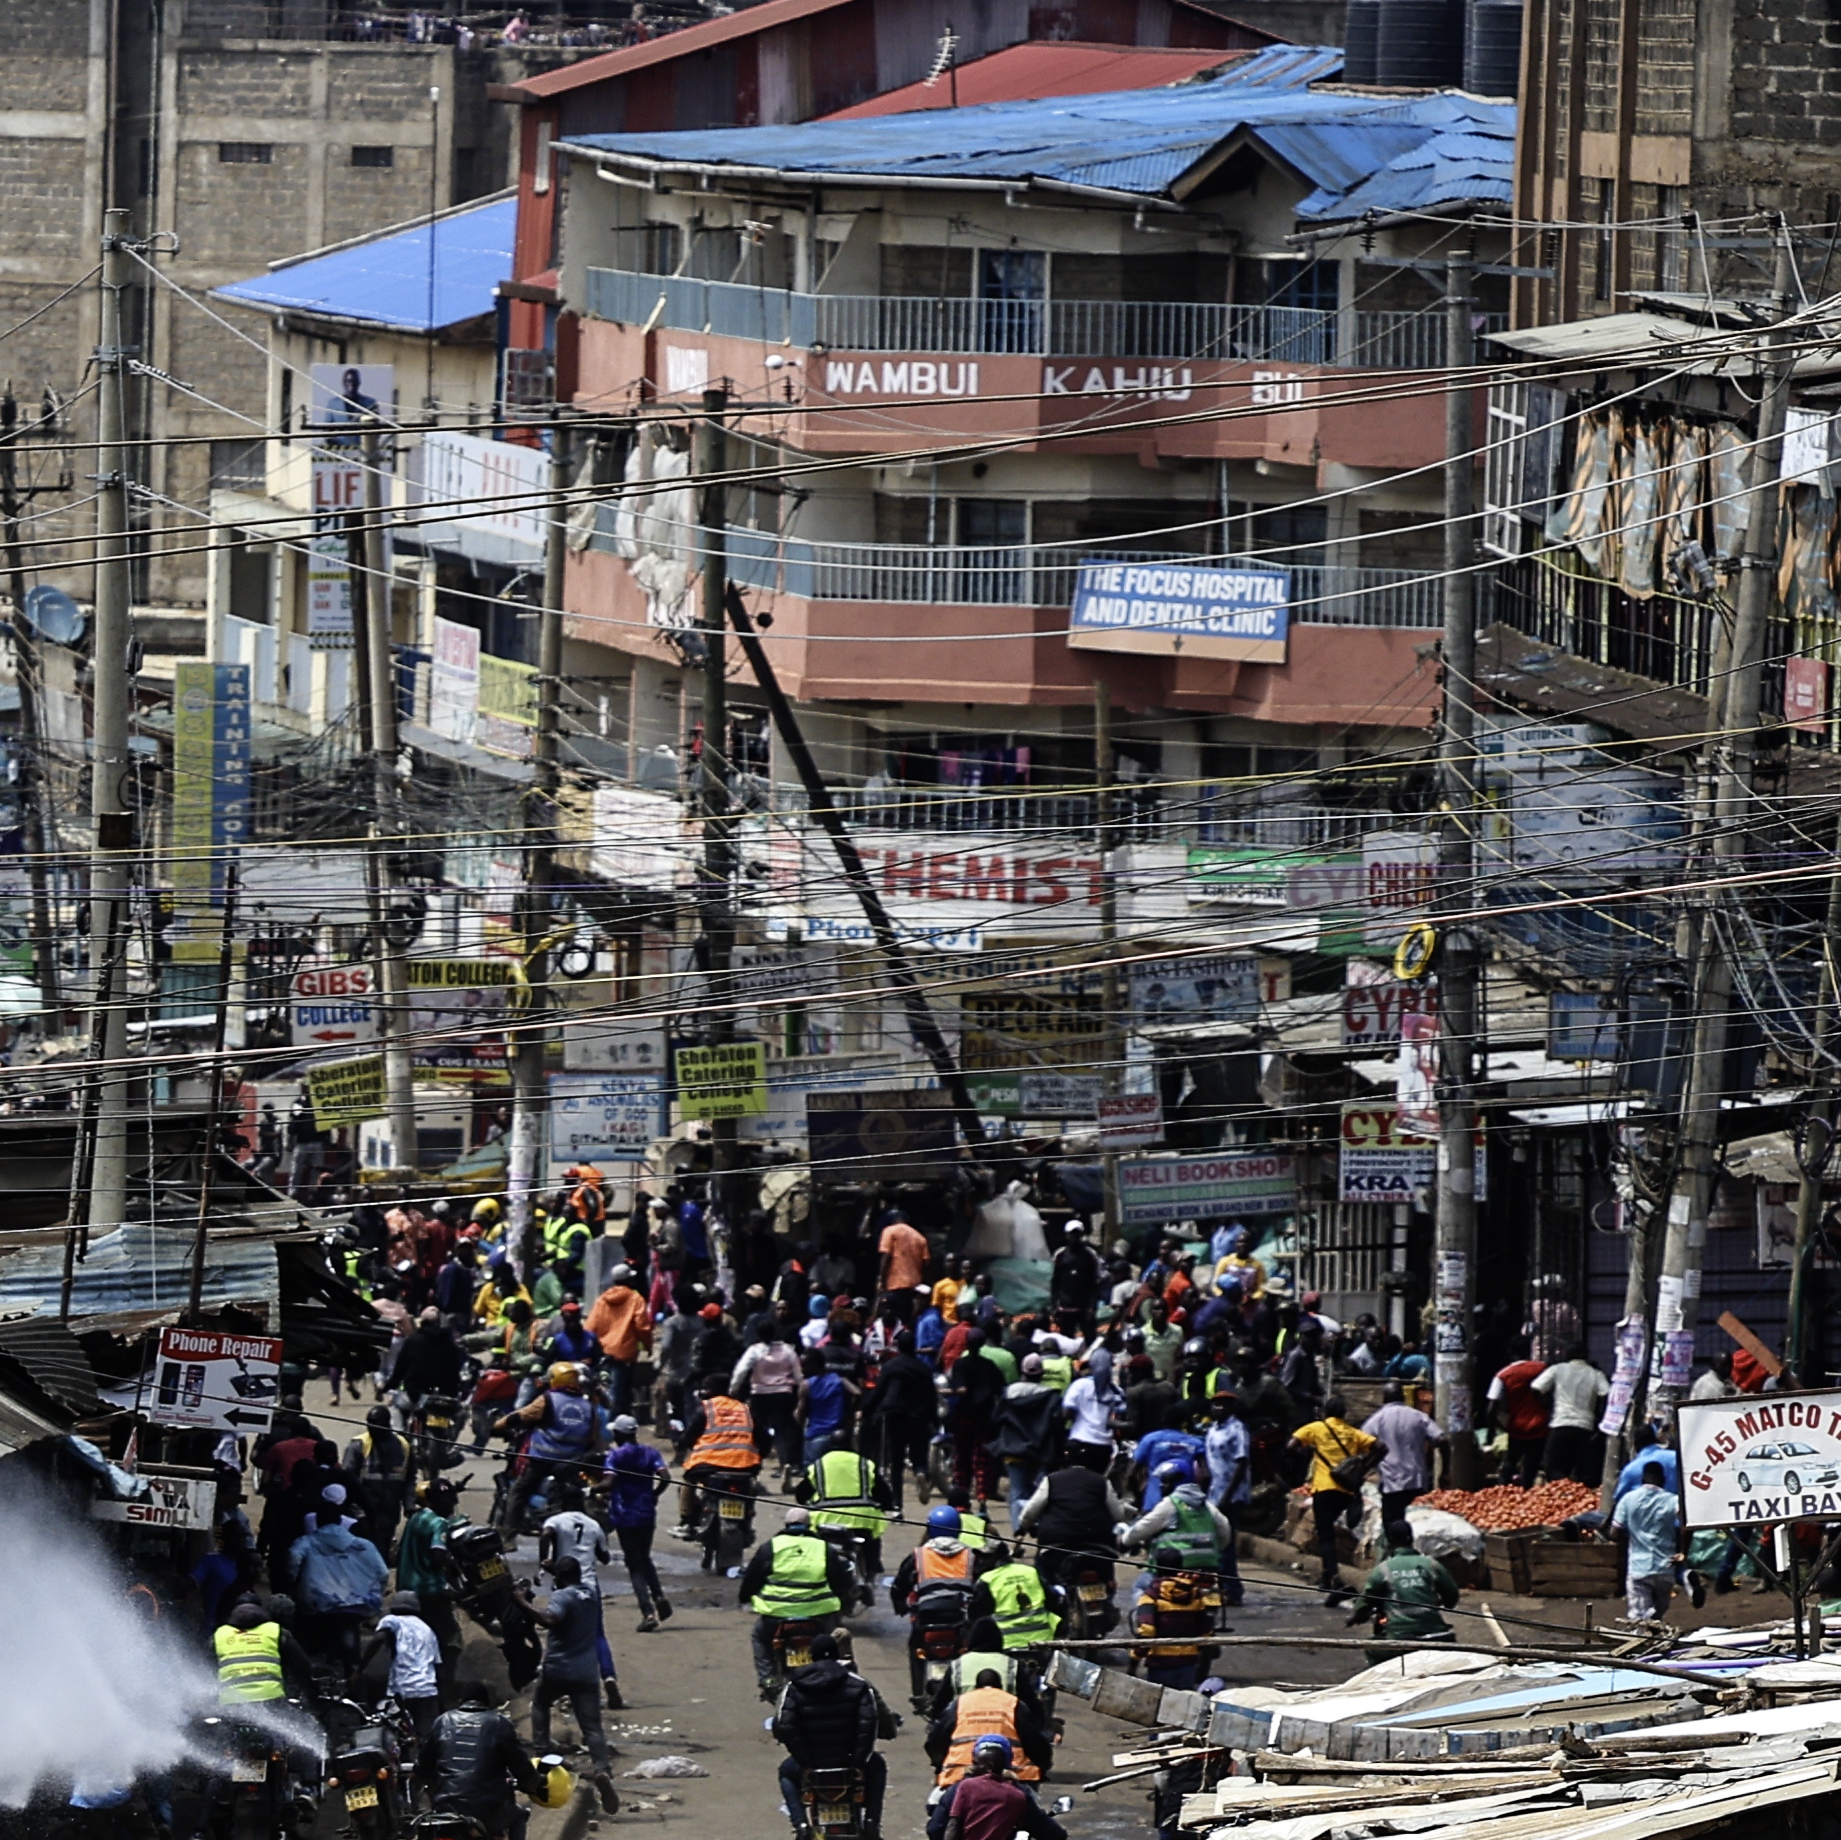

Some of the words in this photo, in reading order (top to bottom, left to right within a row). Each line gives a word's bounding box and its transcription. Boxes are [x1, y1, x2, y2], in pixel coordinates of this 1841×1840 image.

[825, 361, 980, 396] WAMBUI
[1042, 364, 1194, 402] KAHIU
[1083, 567, 1125, 593] THE
[1124, 568, 1193, 599] FOCUS
[1191, 572, 1287, 604] HOSPITAL
[1082, 597, 1128, 624] AND
[1128, 599, 1206, 631] DENTAL
[1206, 605, 1277, 636] CLINIC
[224, 666, 245, 786] TRAINING
[856, 849, 1109, 906] HEMIST
[295, 969, 370, 997] GIBS
[297, 1002, 372, 1027] COLLEGE
[677, 1046, 757, 1067] Sheraton
[681, 1063, 757, 1083] Catering
[1124, 1166, 1172, 1186] NELI
[1176, 1156, 1291, 1183] BOOKSHOP
[1344, 1175, 1409, 1191] KRA
[168, 1332, 218, 1353] Phone
[220, 1336, 273, 1359] Repair
[1688, 1429, 1738, 1492] G-45
[1734, 1402, 1822, 1442] MATCO
[1728, 1497, 1790, 1522] TAXI
[573, 1522, 585, 1546] 7
